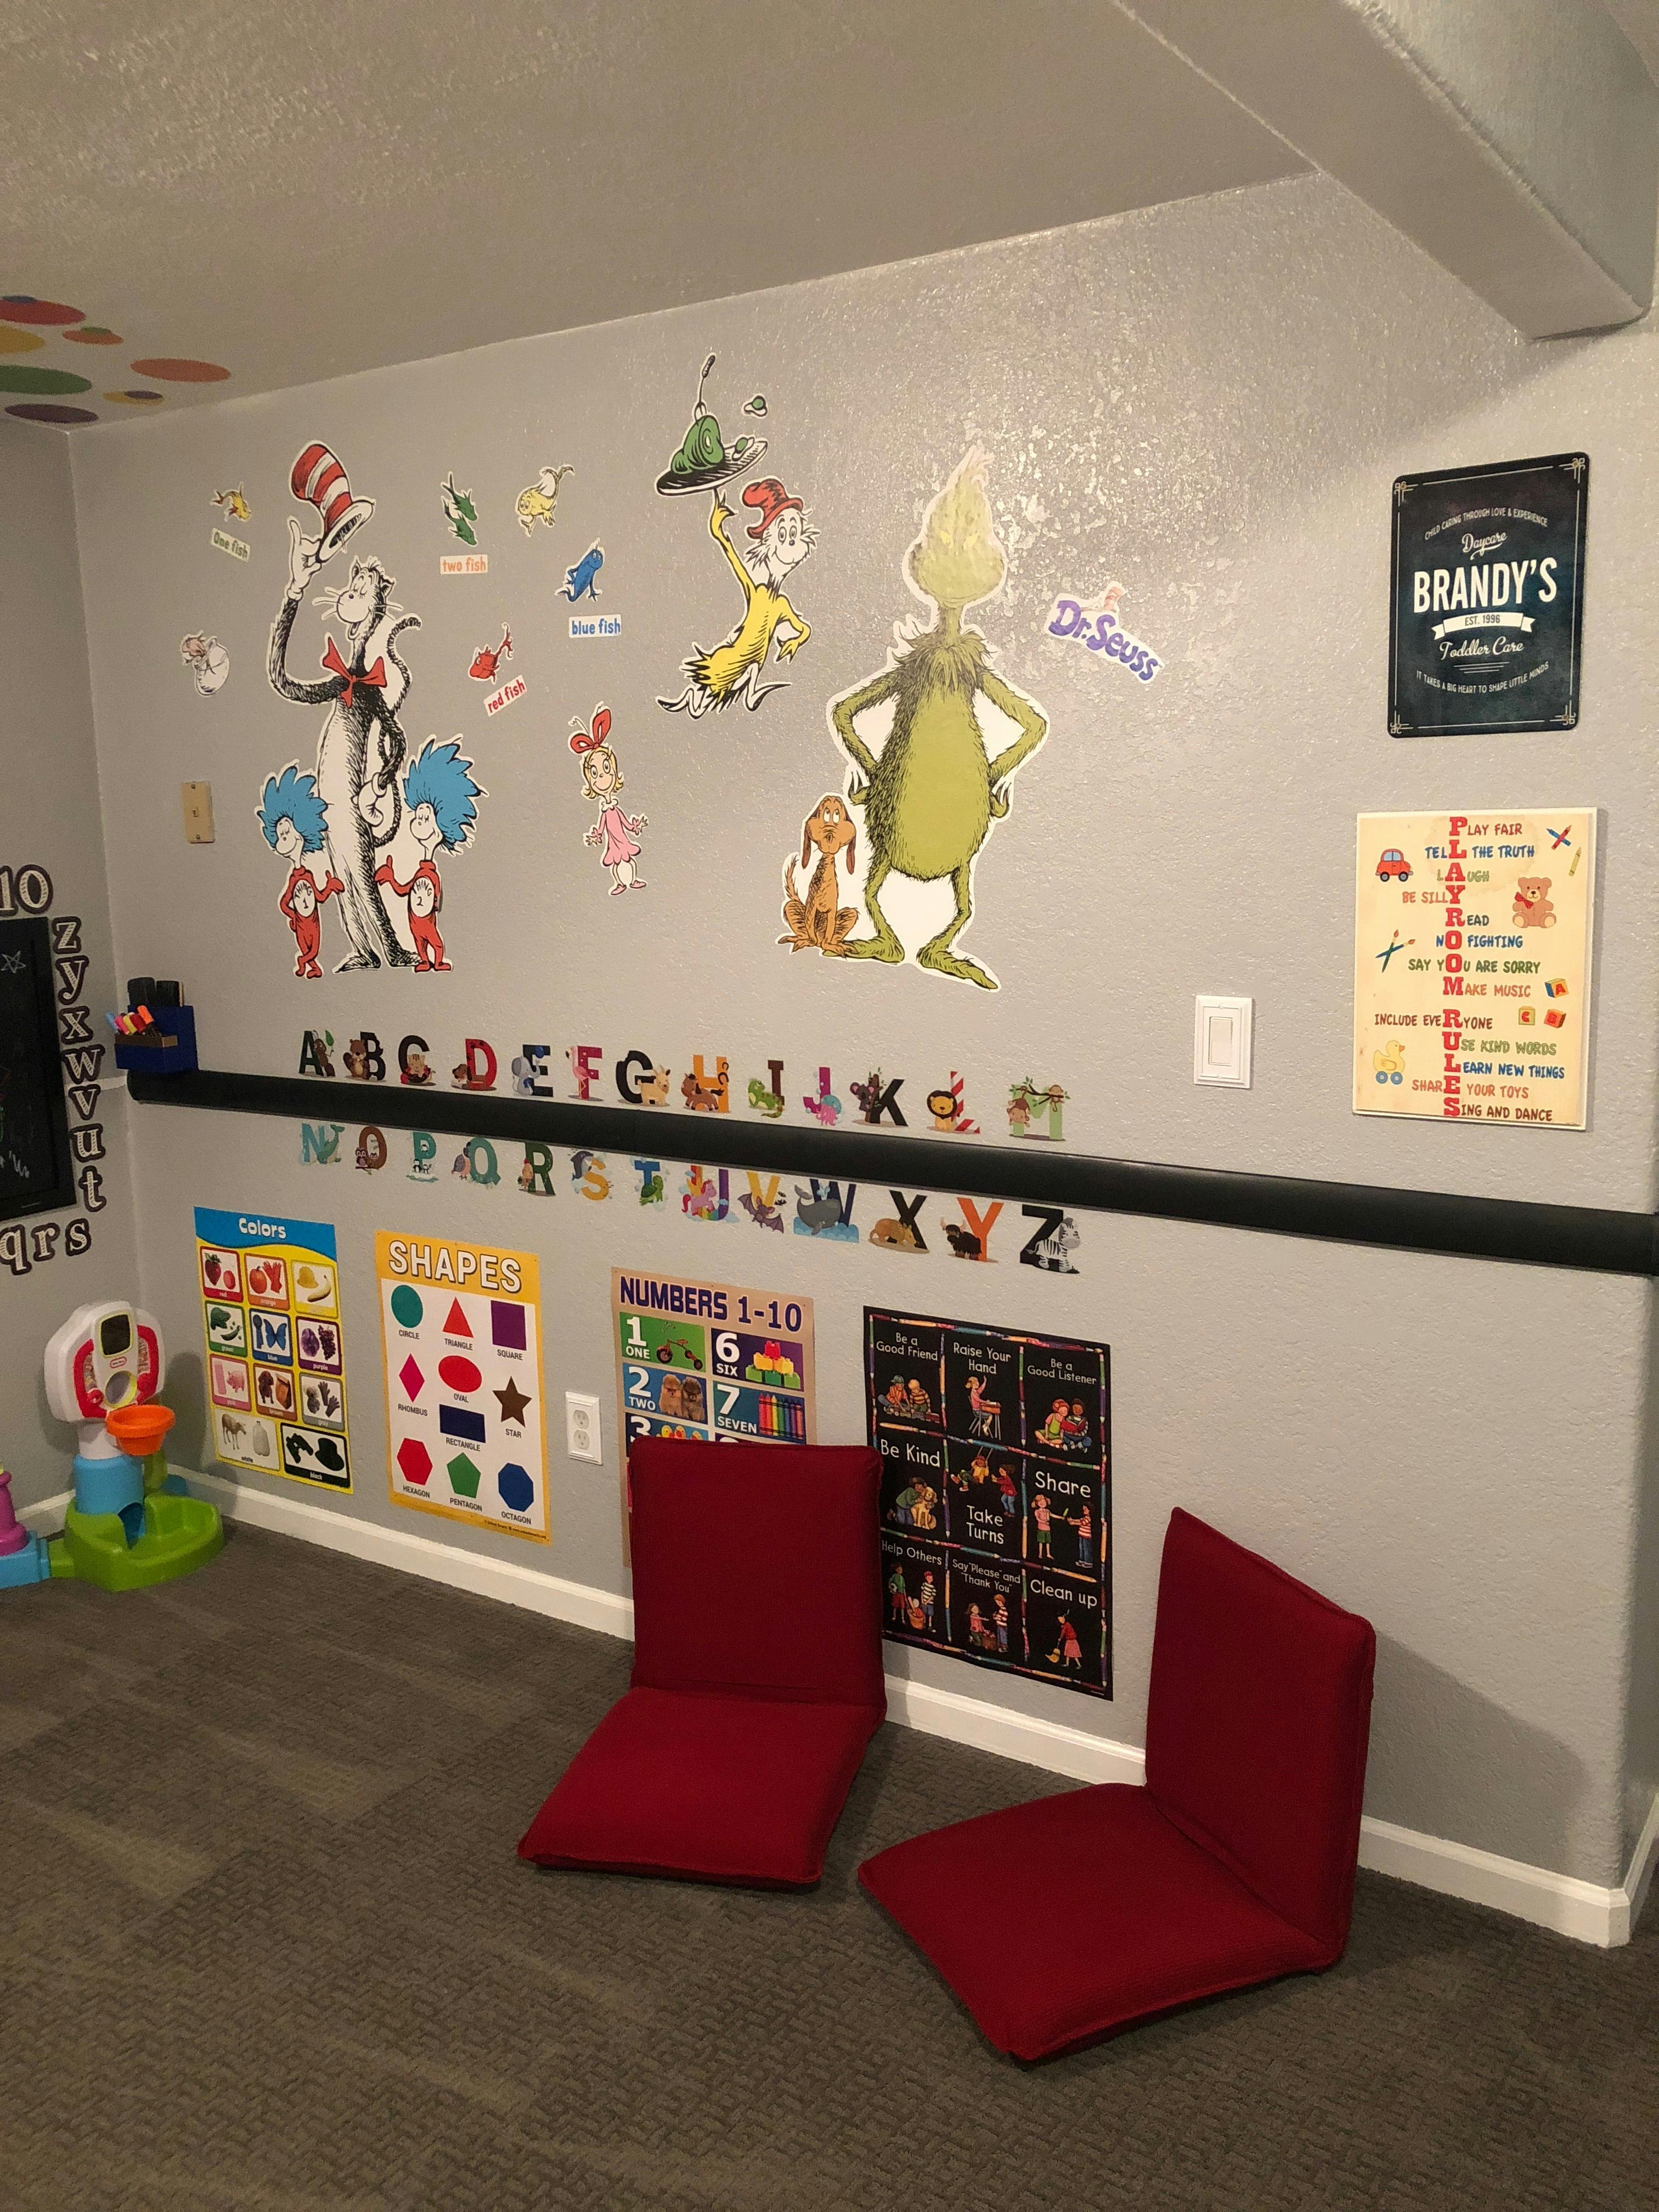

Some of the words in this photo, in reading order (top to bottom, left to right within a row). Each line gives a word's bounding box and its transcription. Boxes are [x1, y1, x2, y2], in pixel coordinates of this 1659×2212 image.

[1425, 524, 1440, 540] CHILD
[1442, 515, 1462, 530] CARING
[1463, 508, 1489, 521] THROUGH
[1491, 507, 1506, 517] LOVE
[1508, 508, 1511, 517] &
[1513, 509, 1548, 527] EXPERIENCE
[232, 539, 247, 558] fish
[1462, 532, 1508, 560] Daycare
[443, 559, 462, 572] two
[465, 557, 486, 571] fish
[1413, 557, 1558, 613] BRANDY'S
[572, 620, 595, 635] blue
[599, 618, 620, 634] fish
[1464, 616, 1480, 627] EST.
[1482, 614, 1500, 624] 1996
[1440, 639, 1491, 660] Toddler
[1492, 636, 1524, 655] Care
[1416, 670, 1422, 680] IT
[1424, 674, 1441, 688] TAKES
[1442, 681, 1446, 690] A
[1447, 683, 1456, 692] BIG
[1458, 685, 1476, 693] HEART
[1479, 685, 1487, 693] TO
[1489, 681, 1507, 692] SHAPE
[1509, 674, 1528, 687] LITTLE
[1528, 661, 1549, 680] MINDS
[488, 691, 504, 714] red
[504, 679, 526, 701] fish
[1449, 816, 1488, 837] PLAY
[1494, 823, 1523, 836] FAIR
[1425, 839, 1466, 859] TELL
[1472, 845, 1493, 858] THE
[1498, 845, 1534, 858] TRUTH
[1436, 862, 1490, 882] LAUGH
[294, 881, 313, 899] THING
[411, 879, 432, 897] THING
[1402, 891, 1416, 904] BE
[1421, 884, 1465, 904] SILLY
[302, 897, 309, 909] 1
[416, 896, 424, 906] 2
[1446, 907, 1489, 927] READ
[1436, 930, 1463, 950] NO
[1467, 934, 1523, 948] FIGHTING
[1408, 958, 1431, 971] SAY
[1437, 953, 1471, 973] YOU
[1475, 960, 1499, 973] ARE
[1503, 961, 1541, 974] SORRY
[1443, 976, 1487, 996] MAKE
[1494, 984, 1531, 997] MUSIC
[1374, 1013, 1418, 1026] INCLUDE
[1423, 1008, 1493, 1029] EVERYONE
[1442, 1031, 1475, 1052] USE
[1481, 1040, 1510, 1053] KIND
[1516, 1042, 1556, 1056] WORDS
[465, 1039, 498, 1091] D
[522, 1044, 554, 1097] E
[577, 1046, 602, 1099] F
[693, 1054, 729, 1113] H
[1444, 1053, 1492, 1075] LEARN
[1498, 1063, 1524, 1076] NEW
[1528, 1065, 1565, 1079] THINGS
[1412, 1075, 1460, 1093] SHARE
[1466, 1084, 1496, 1096] YOUR
[1500, 1085, 1529, 1098] TOYS
[1443, 1097, 1481, 1118] SING
[1487, 1105, 1510, 1118] AND
[1515, 1108, 1553, 1122] DANCE
[358, 1126, 387, 1170] O
[466, 1137, 501, 1186] Q
[524, 1142, 555, 1195] R
[957, 1197, 1004, 1262] Y
[1020, 1204, 1068, 1272] Z
[239, 1217, 286, 1239] Colors
[388, 1240, 522, 1294] SHAPES
[620, 1276, 727, 1321] NUMBERS
[738, 1296, 802, 1332] 1-10
[398, 1329, 420, 1340] CIRCLE
[627, 1316, 647, 1347] 1
[896, 1332, 908, 1343] Be
[911, 1337, 918, 1346] a
[444, 1338, 473, 1351] TRIANGLE
[497, 1349, 523, 1361] SQUARE
[625, 1346, 650, 1359] ONE
[715, 1333, 740, 1363] 6
[876, 1341, 904, 1356] Good
[908, 1346, 938, 1361] Friend
[953, 1342, 983, 1357] Raise
[987, 1348, 1011, 1363] Your
[716, 1364, 738, 1377] SIX
[968, 1359, 996, 1375] Hand
[1051, 1358, 1062, 1369] Be
[1065, 1363, 1073, 1371] a
[629, 1367, 652, 1398] 2
[1028, 1365, 1055, 1378] Good
[1058, 1371, 1097, 1386] Listener
[453, 1393, 469, 1403] OVAL
[629, 1397, 656, 1411] TWO
[716, 1384, 740, 1415] 7
[398, 1403, 428, 1417] RHOMBUS
[505, 1428, 522, 1438] STAR
[630, 1416, 651, 1442] 3
[718, 1416, 757, 1434] SEVEN
[445, 1437, 481, 1452] RECTANGLE
[881, 1438, 899, 1458] Be
[906, 1443, 940, 1468] Kind
[403, 1485, 430, 1499] HEXAGON
[1035, 1471, 1091, 1498] Share
[449, 1497, 482, 1511] PENTAGON
[501, 1511, 532, 1525] OCTAGON
[966, 1505, 1003, 1527] Take
[966, 1522, 1004, 1544] Turns
[882, 1539, 903, 1556] Help
[906, 1547, 942, 1565] Others
[952, 1559, 968, 1572] Say
[1003, 1573, 1020, 1584] and
[1030, 1579, 1073, 1601] Clean
[1079, 1592, 1097, 1608] up
